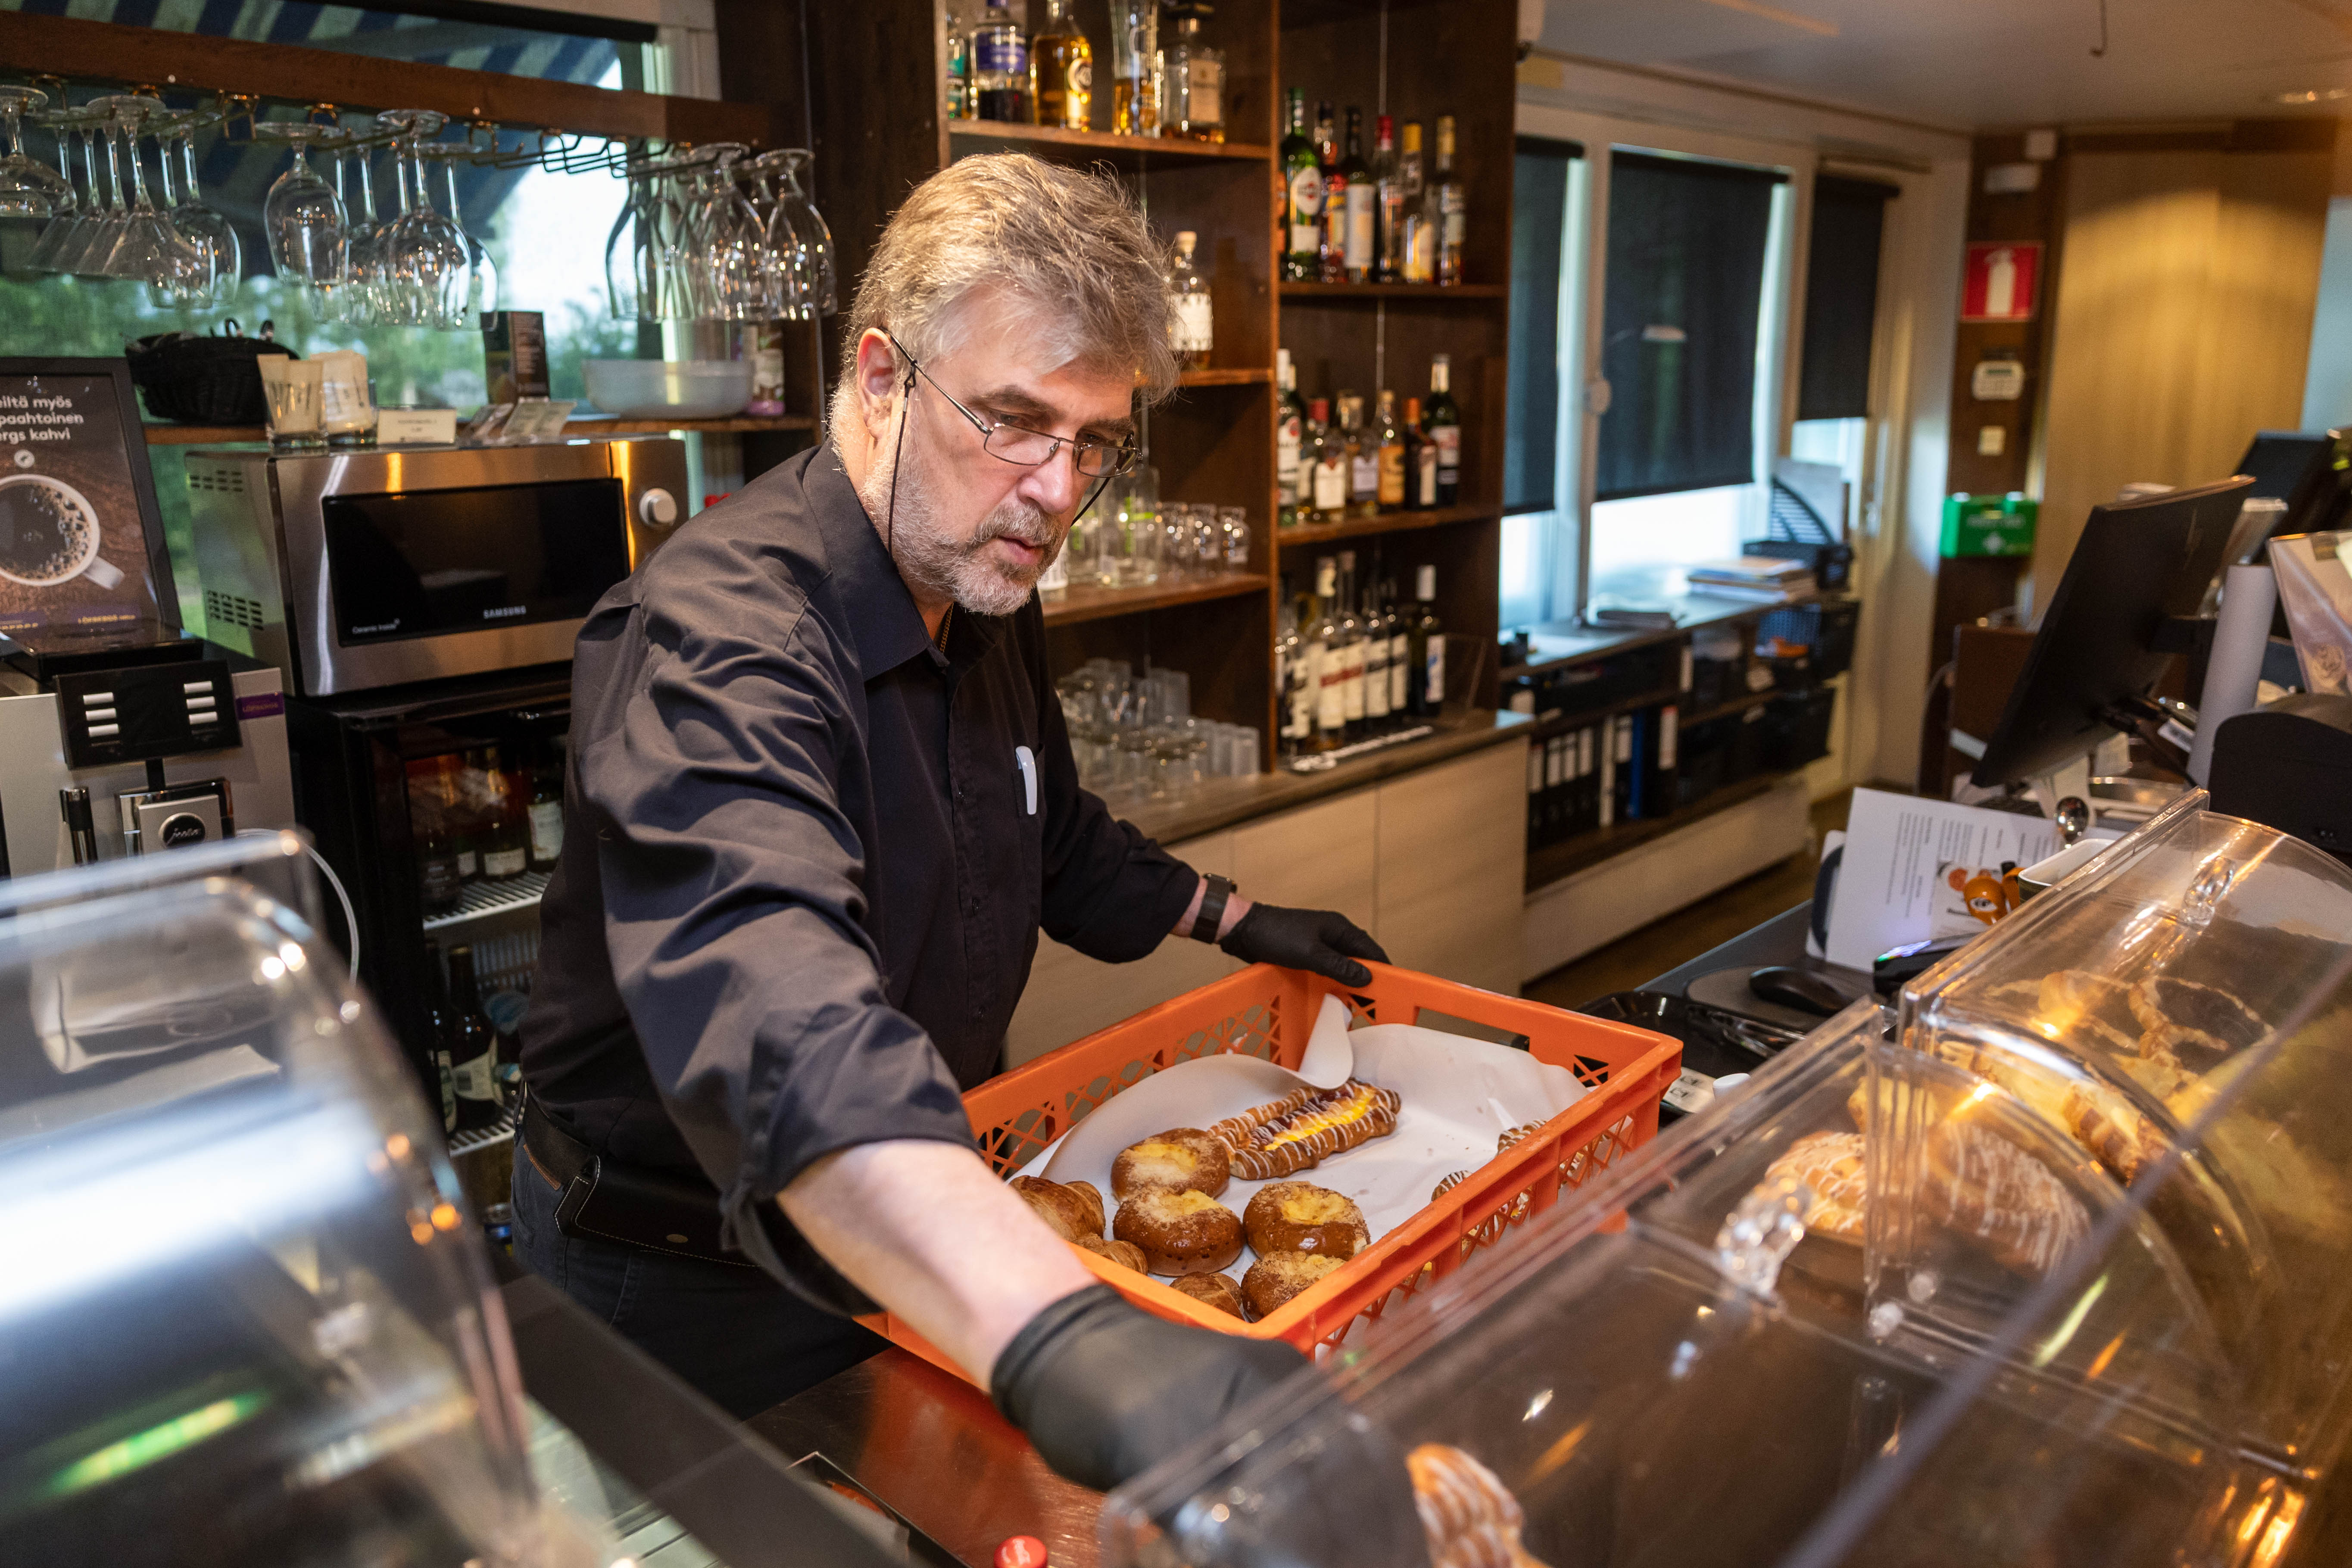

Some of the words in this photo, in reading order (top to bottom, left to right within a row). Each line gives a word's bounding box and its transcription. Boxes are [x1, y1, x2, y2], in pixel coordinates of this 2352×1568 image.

[32, 395, 72, 411] myös
[0, 431, 26, 445] rgs
[29, 427, 71, 441] kahvi
[484, 605, 526, 619] SAMSUNG
